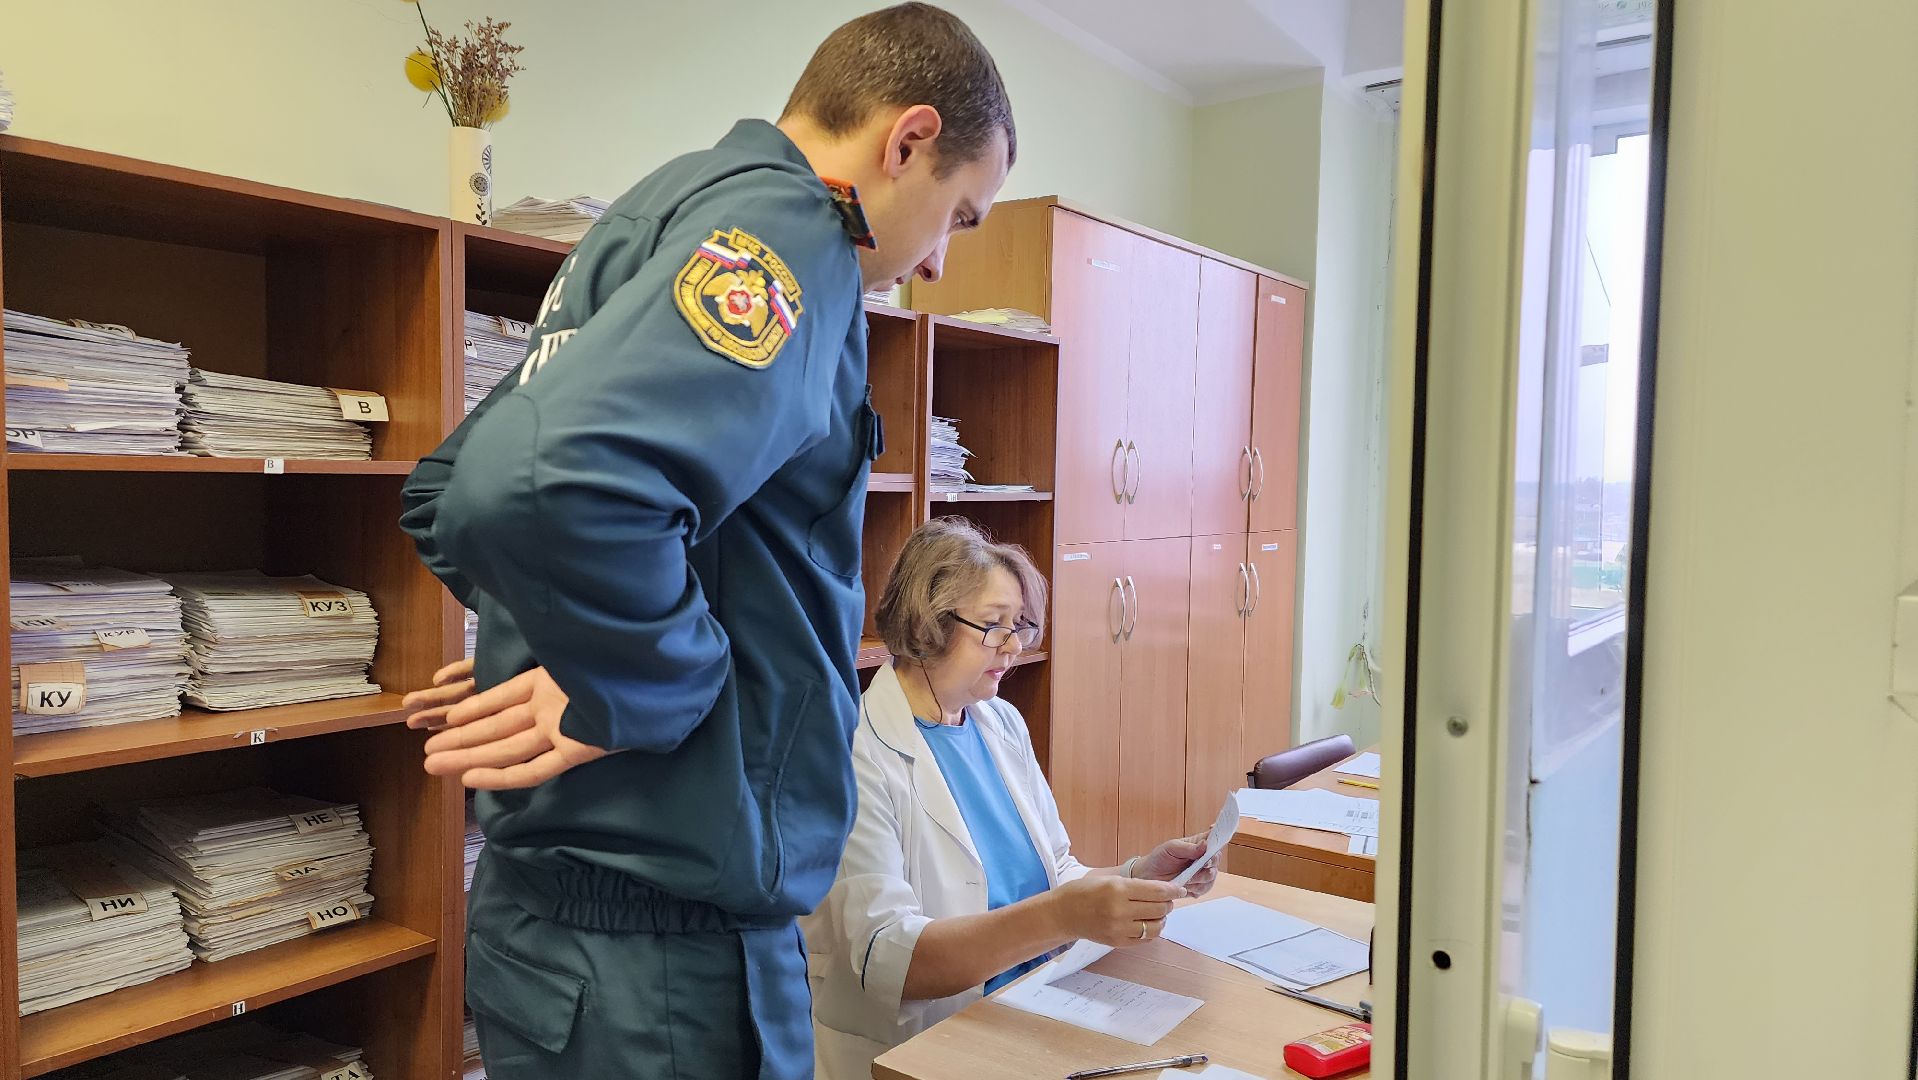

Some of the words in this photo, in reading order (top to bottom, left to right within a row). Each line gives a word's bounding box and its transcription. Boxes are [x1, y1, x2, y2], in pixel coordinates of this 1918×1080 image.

[357, 401, 372, 414] В
[267, 459, 274, 469] В
[309, 601, 348, 612] КУЗ
[39, 690, 73, 708] КУ
[253, 732, 264, 744] К
[303, 813, 333, 827] НЕ
[286, 865, 319, 877] НА
[100, 897, 136, 912] НИ
[316, 905, 348, 921] НО
[233, 1002, 244, 1016] Н
